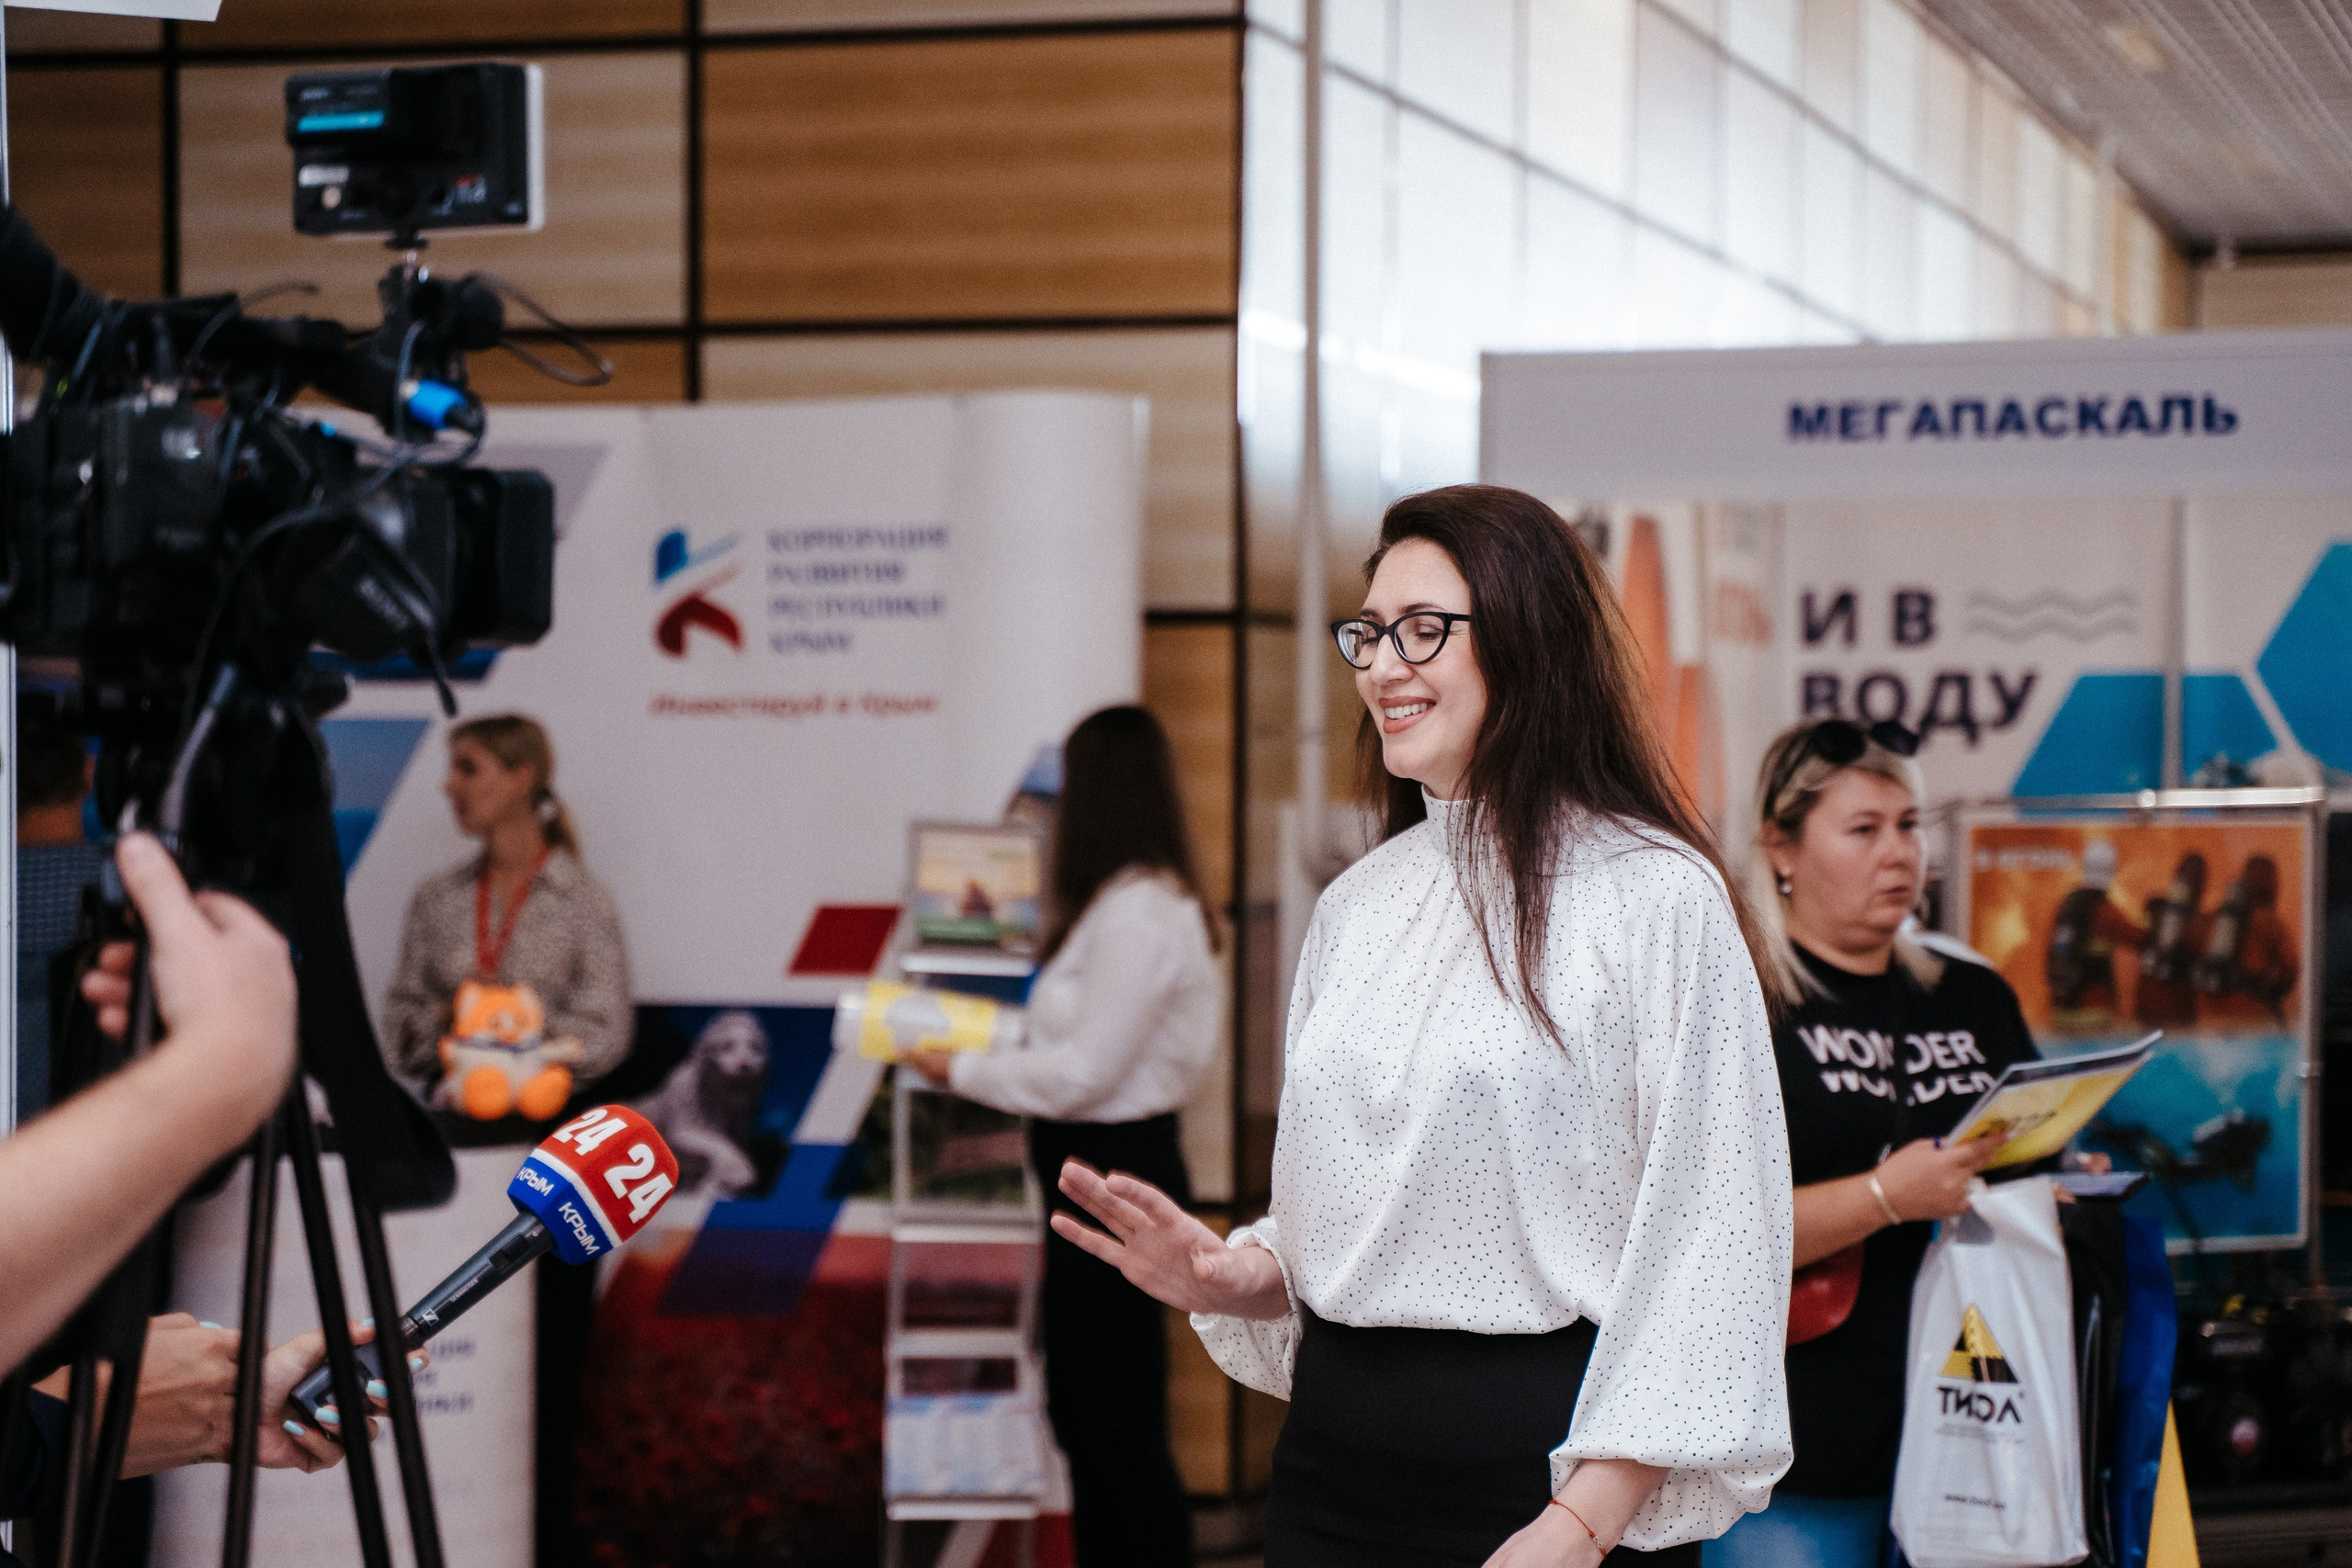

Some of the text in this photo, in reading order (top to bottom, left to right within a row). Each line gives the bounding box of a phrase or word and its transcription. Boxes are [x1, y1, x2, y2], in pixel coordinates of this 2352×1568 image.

[1789, 398, 2239, 441] МЕГАПАСКАЛЬ
[1802, 591, 1858, 646] И
[1890, 591, 1937, 646] В
[1802, 672, 2037, 746] ВОДУ
[552, 1108, 628, 1156] 24
[516, 1166, 555, 1197] КРЫМ
[603, 1143, 673, 1224] 24
[558, 1201, 601, 1256] КРЫМ
